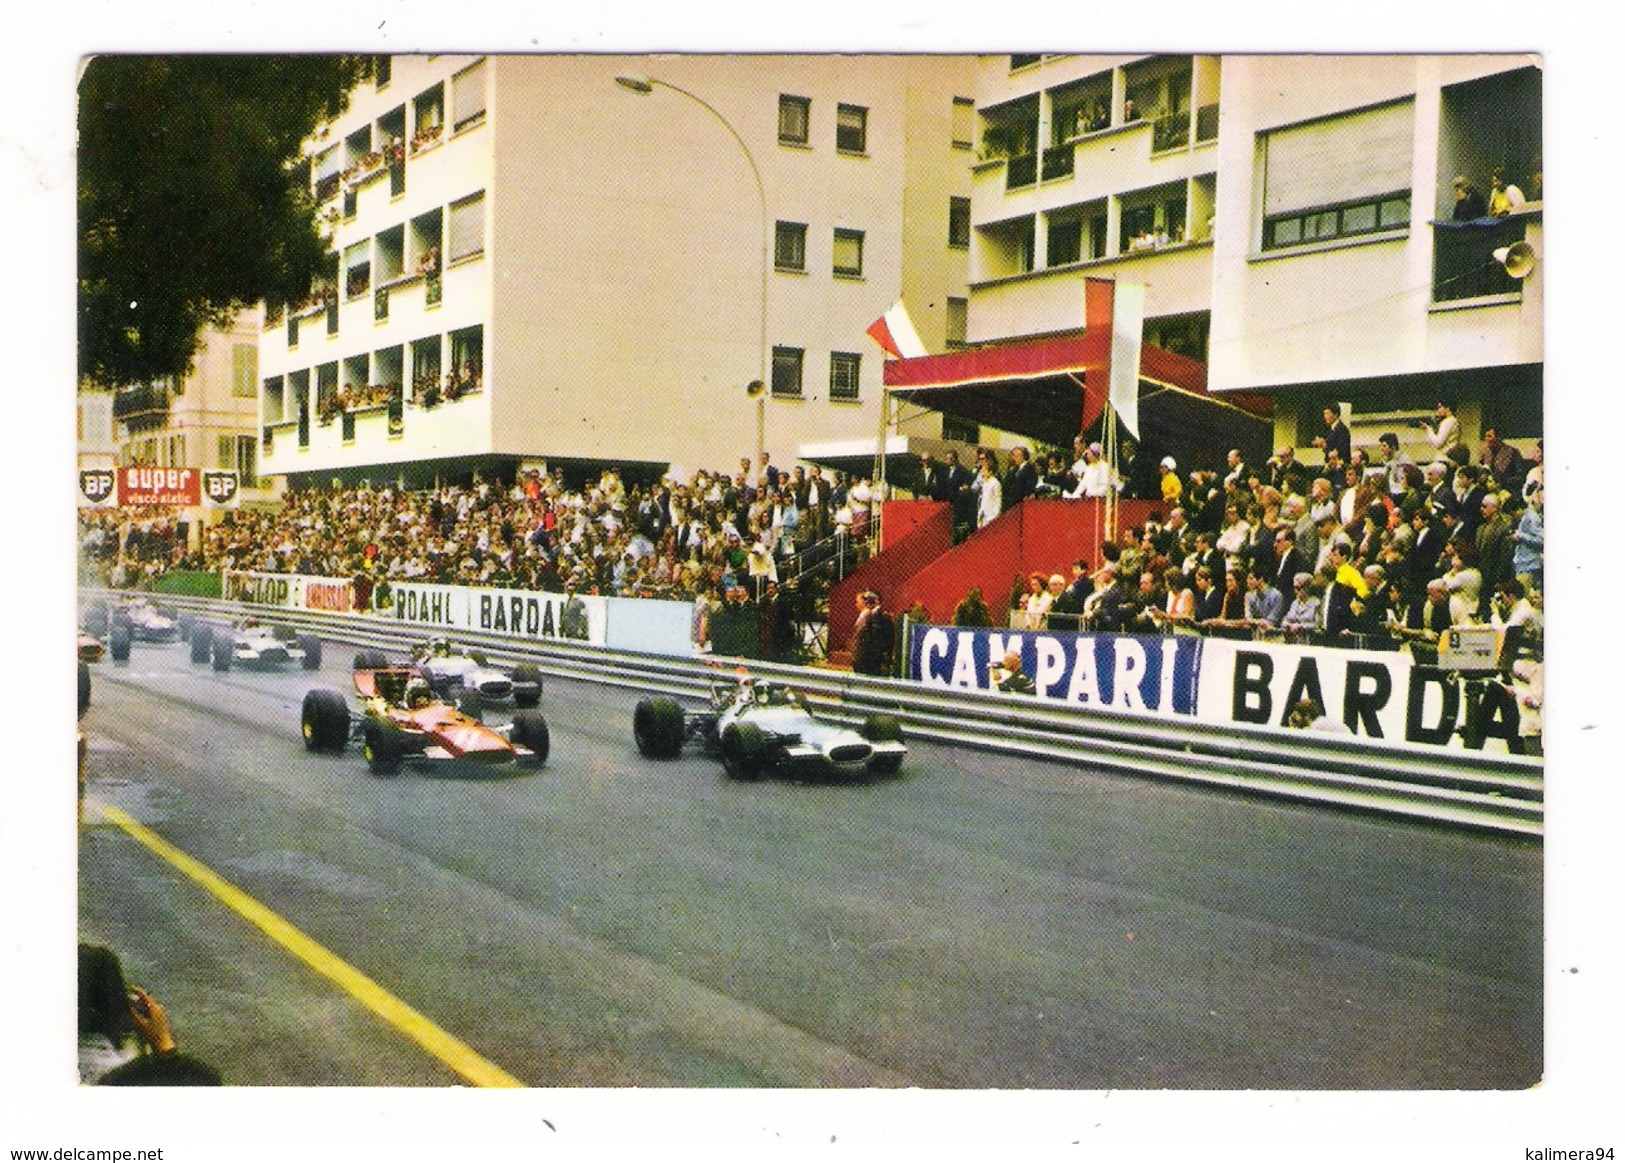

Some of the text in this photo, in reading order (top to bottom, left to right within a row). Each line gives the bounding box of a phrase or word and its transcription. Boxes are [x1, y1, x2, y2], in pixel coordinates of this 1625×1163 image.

[85, 475, 112, 495] BP
[127, 468, 192, 494] super
[208, 477, 235, 496] BP
[396, 588, 454, 625] RDAHL
[480, 594, 589, 641] BARDA
